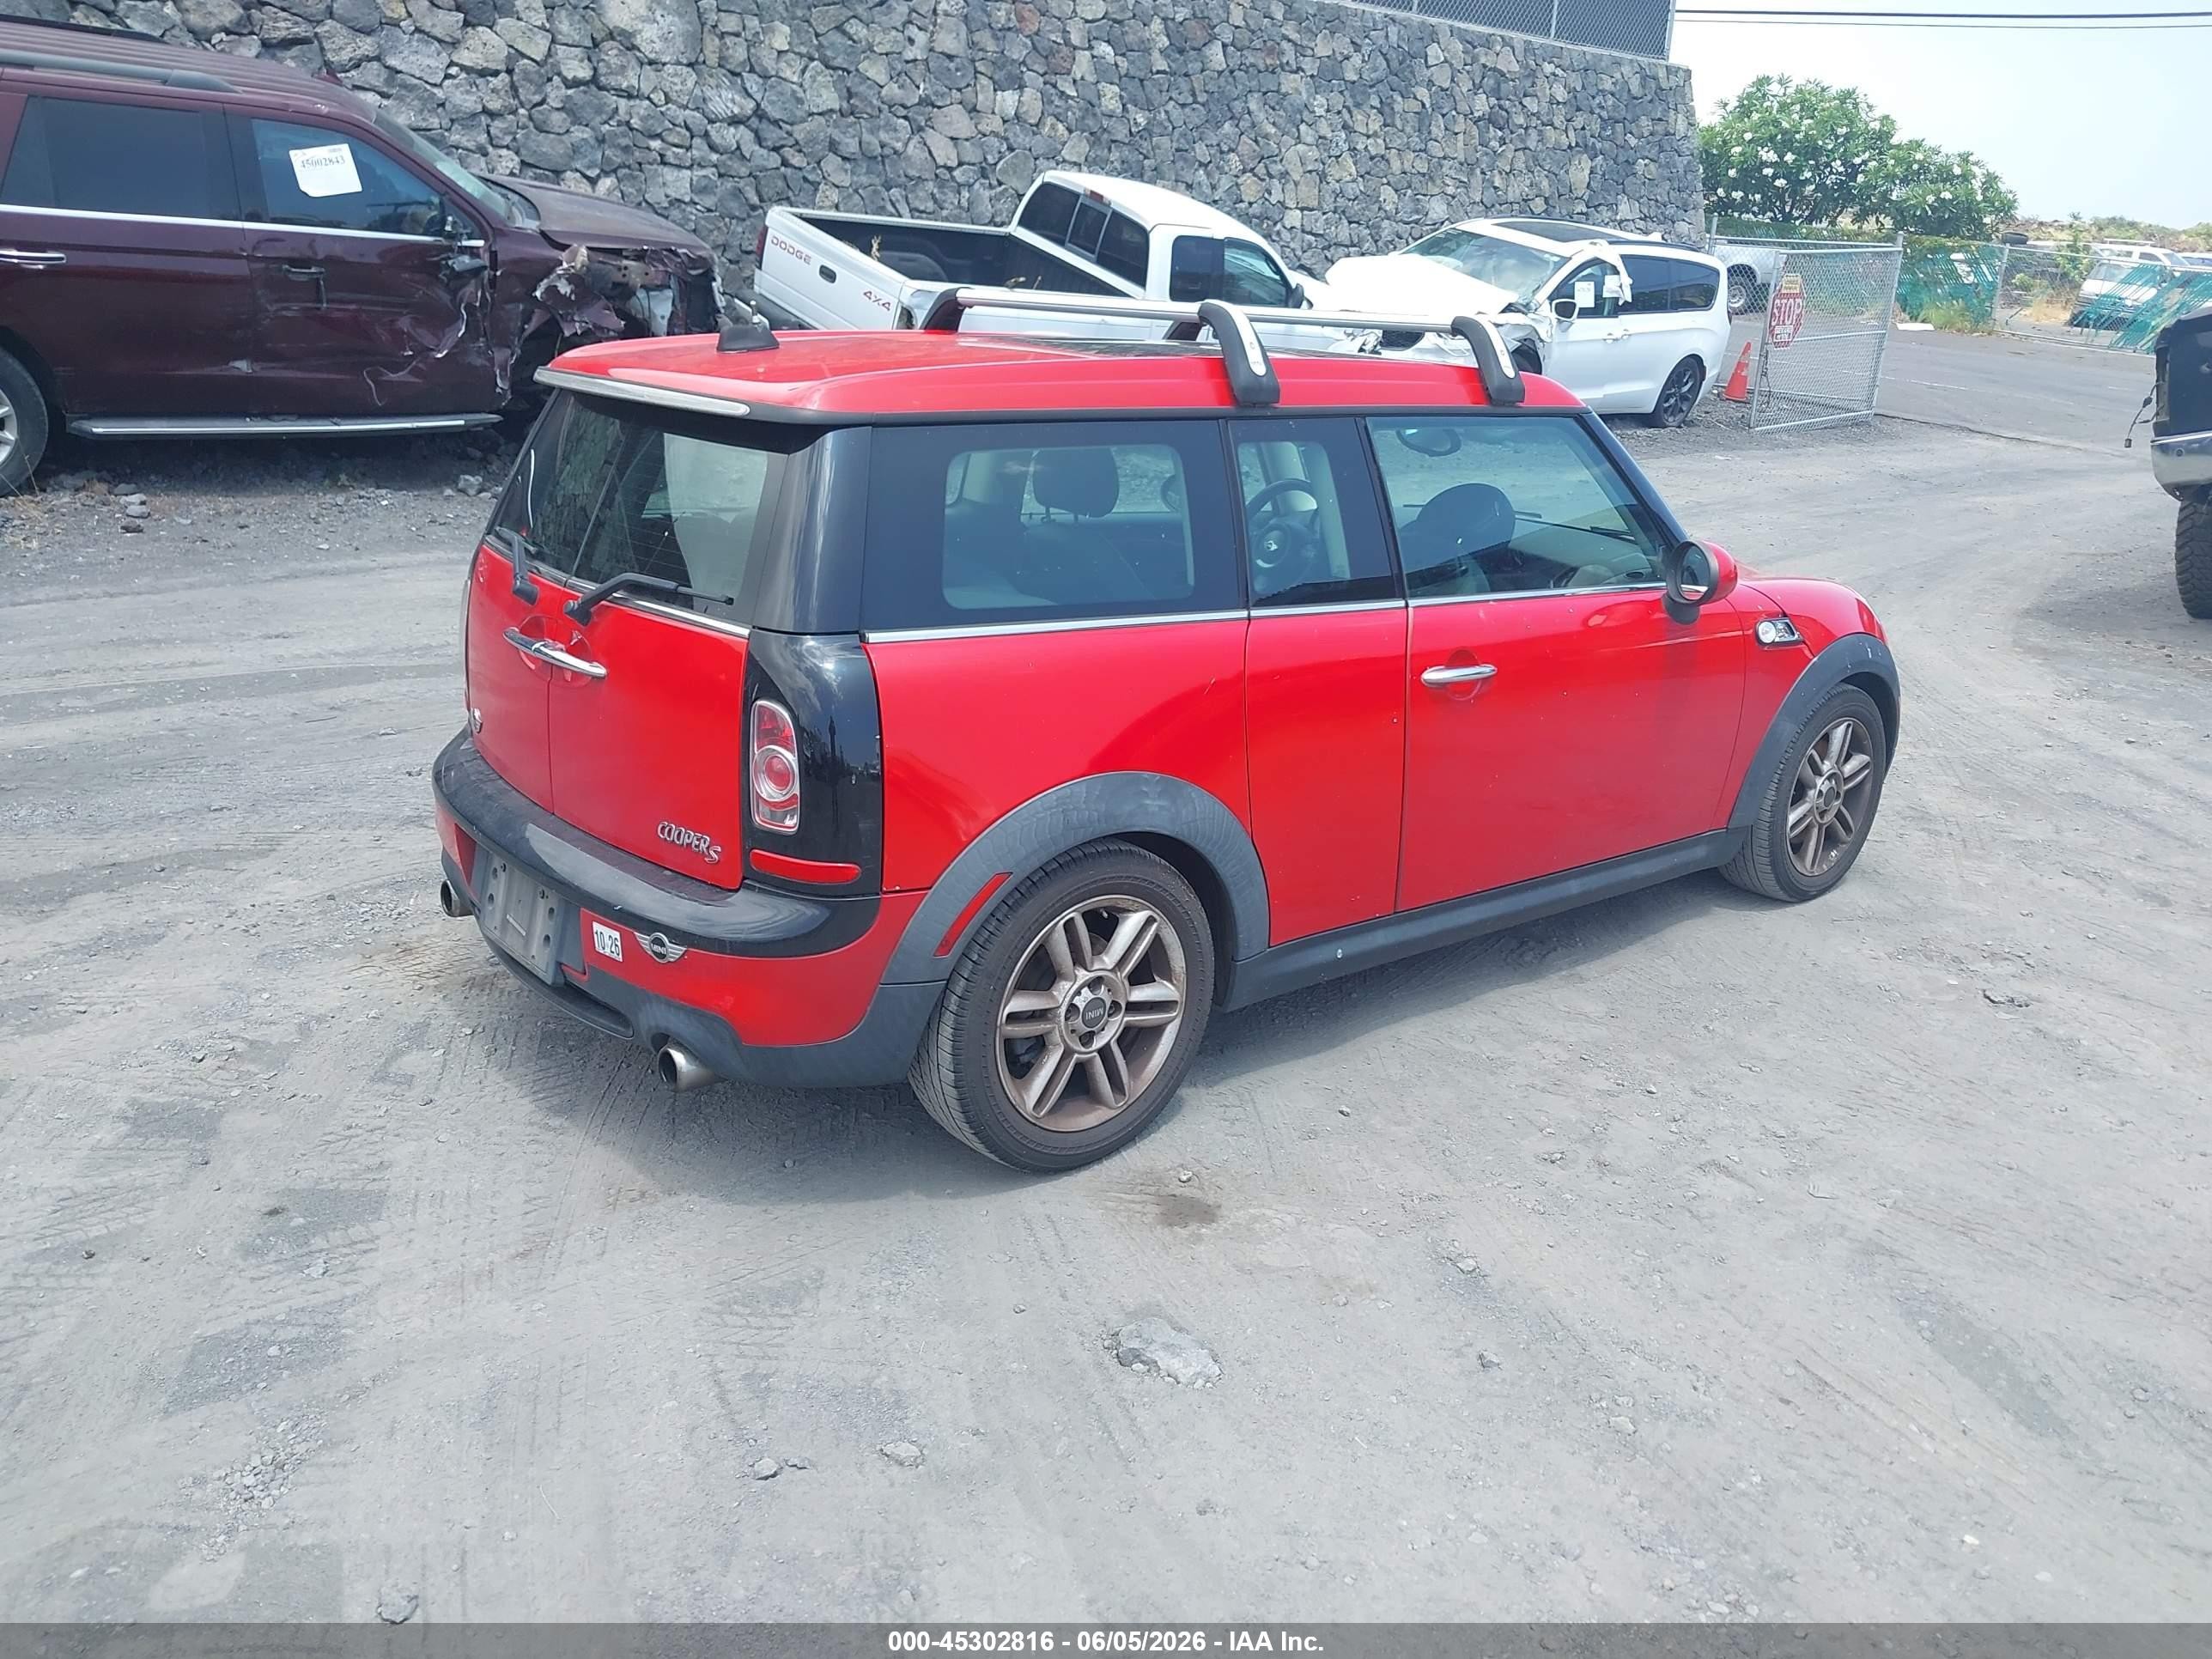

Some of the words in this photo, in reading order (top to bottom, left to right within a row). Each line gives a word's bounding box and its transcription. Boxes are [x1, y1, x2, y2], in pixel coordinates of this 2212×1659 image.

[770, 235, 812, 265] DODGE
[1771, 298, 1802, 325] STOP
[595, 930, 605, 951] 10
[608, 934, 620, 957] 26
[1085, 1006, 1104, 1020] MINI
